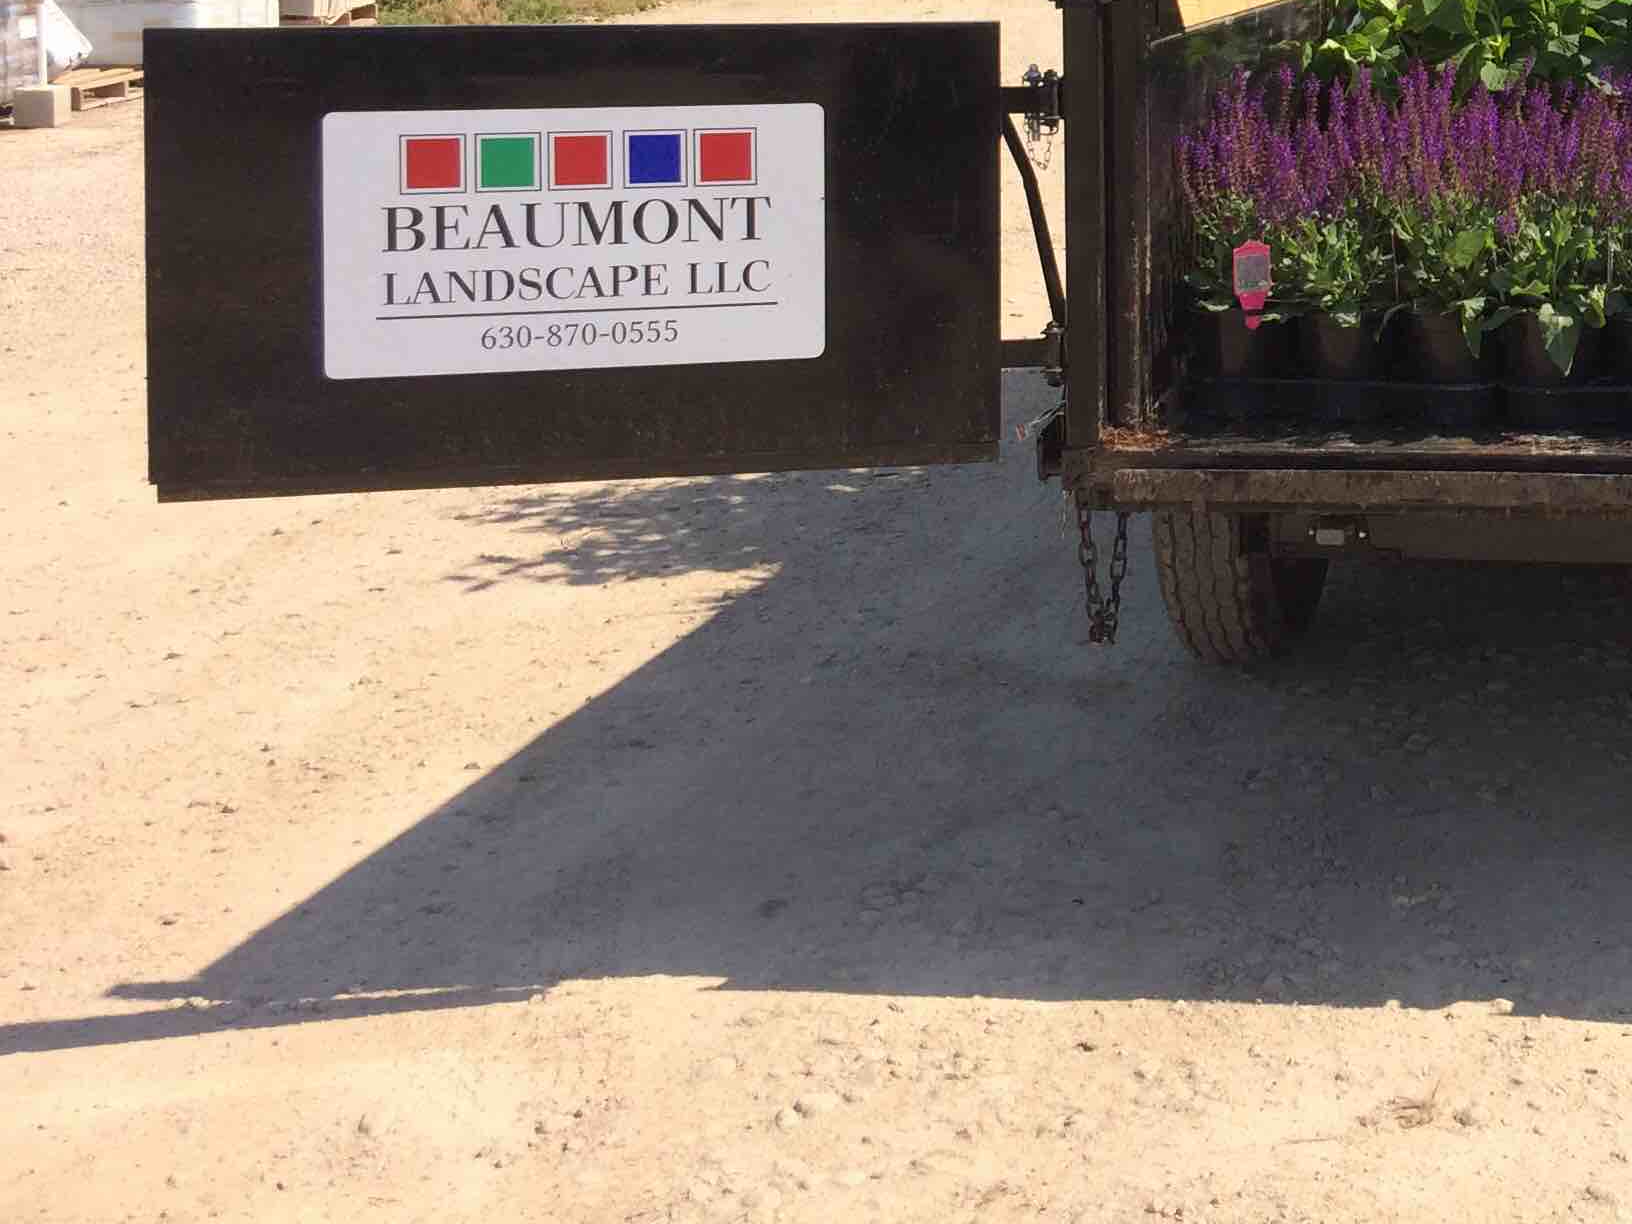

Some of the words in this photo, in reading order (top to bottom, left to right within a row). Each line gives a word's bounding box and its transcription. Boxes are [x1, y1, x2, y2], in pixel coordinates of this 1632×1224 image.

[381, 196, 772, 253] BEAUMONT
[383, 263, 669, 306] LANDSCAPE
[687, 259, 772, 295] LLC
[481, 319, 679, 350] 630-870-0555
